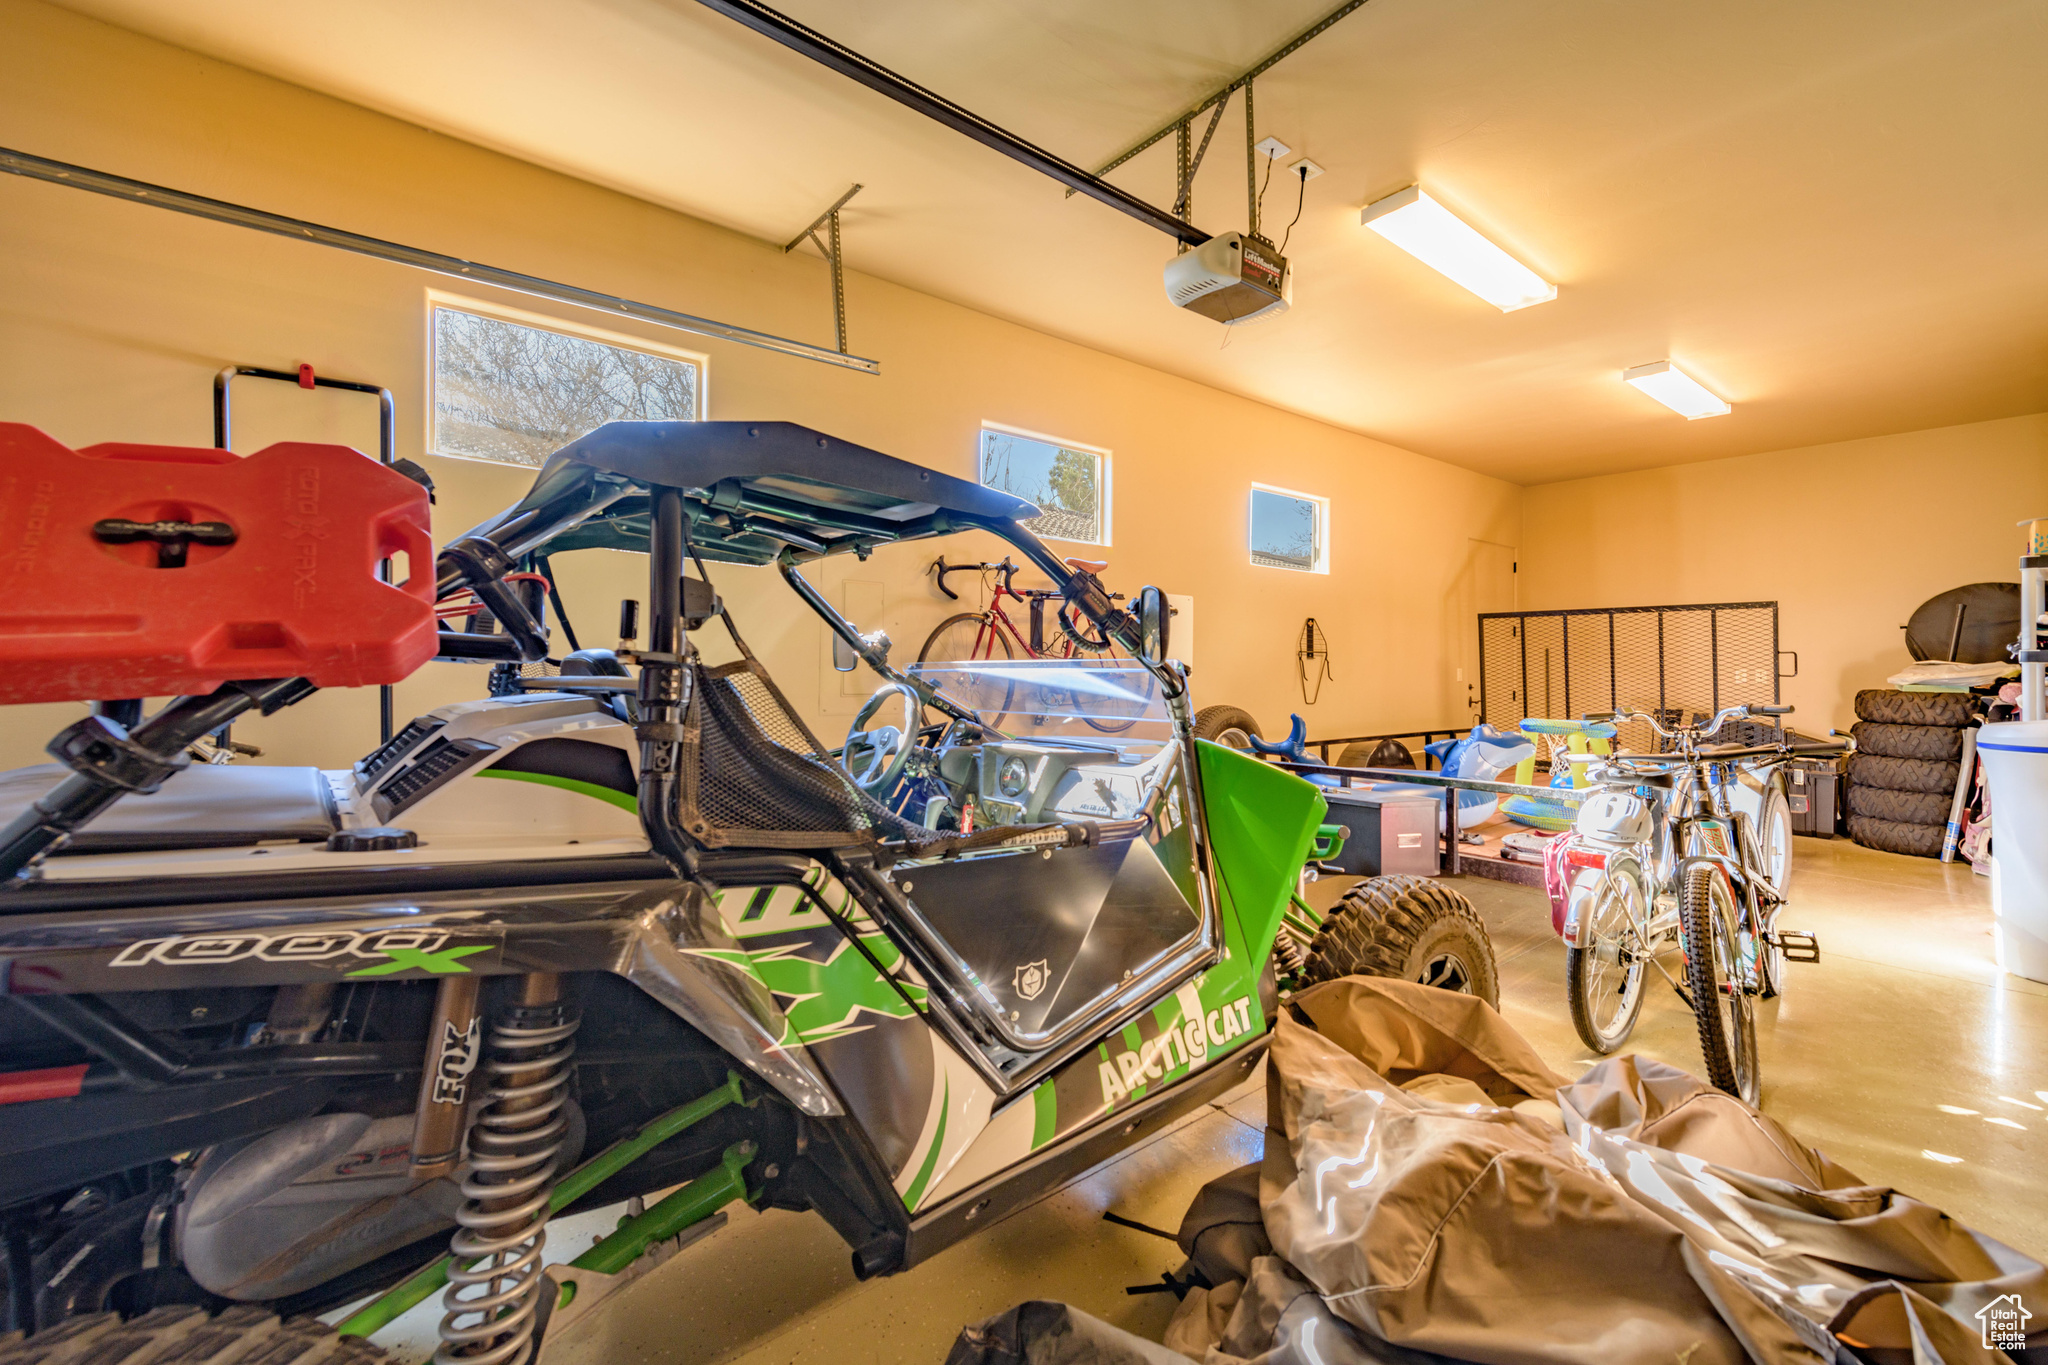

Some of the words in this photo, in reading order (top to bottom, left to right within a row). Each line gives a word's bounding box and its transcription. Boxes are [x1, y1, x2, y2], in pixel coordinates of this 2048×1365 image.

[1712, 830, 1725, 852] CRUZ
[433, 1015, 482, 1106] FOX
[1097, 1018, 1206, 1105] ARCTIC
[1205, 994, 1253, 1047] CAT
